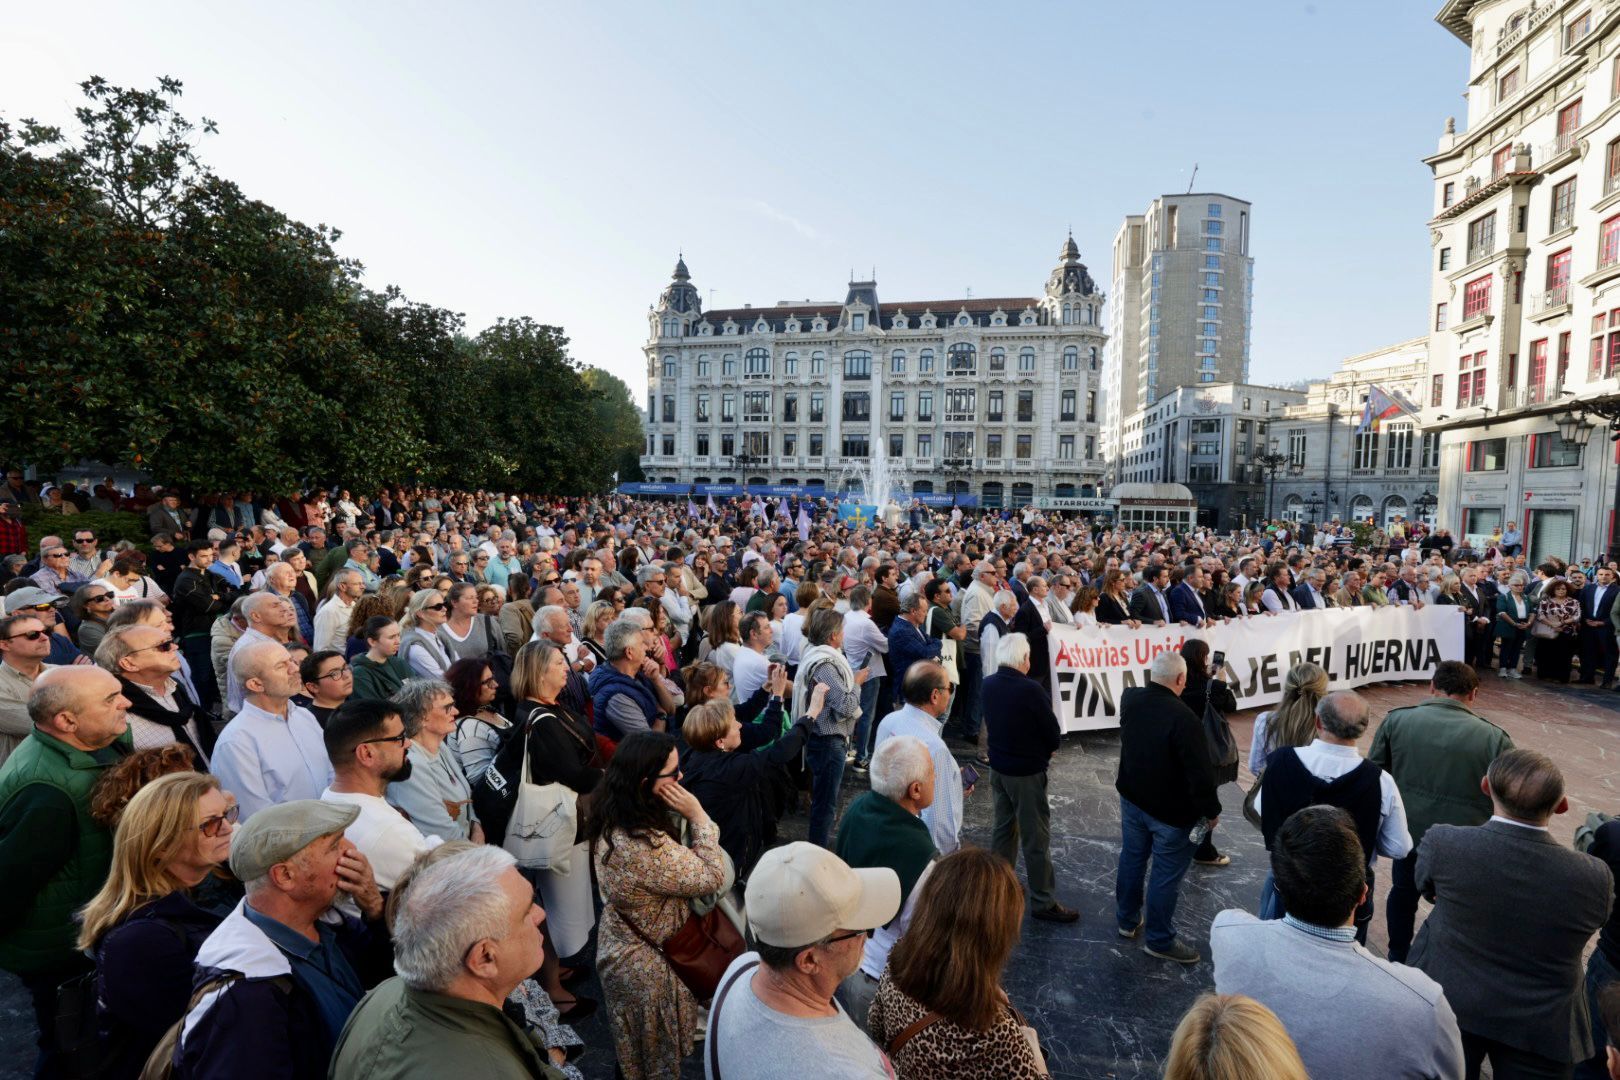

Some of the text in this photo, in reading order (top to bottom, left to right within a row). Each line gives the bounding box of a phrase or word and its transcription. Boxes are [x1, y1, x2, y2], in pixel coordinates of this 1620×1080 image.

[1055, 639, 1130, 668] Asturias
[1345, 638, 1443, 680] HUERNA
[1056, 672, 1116, 718] FIN
